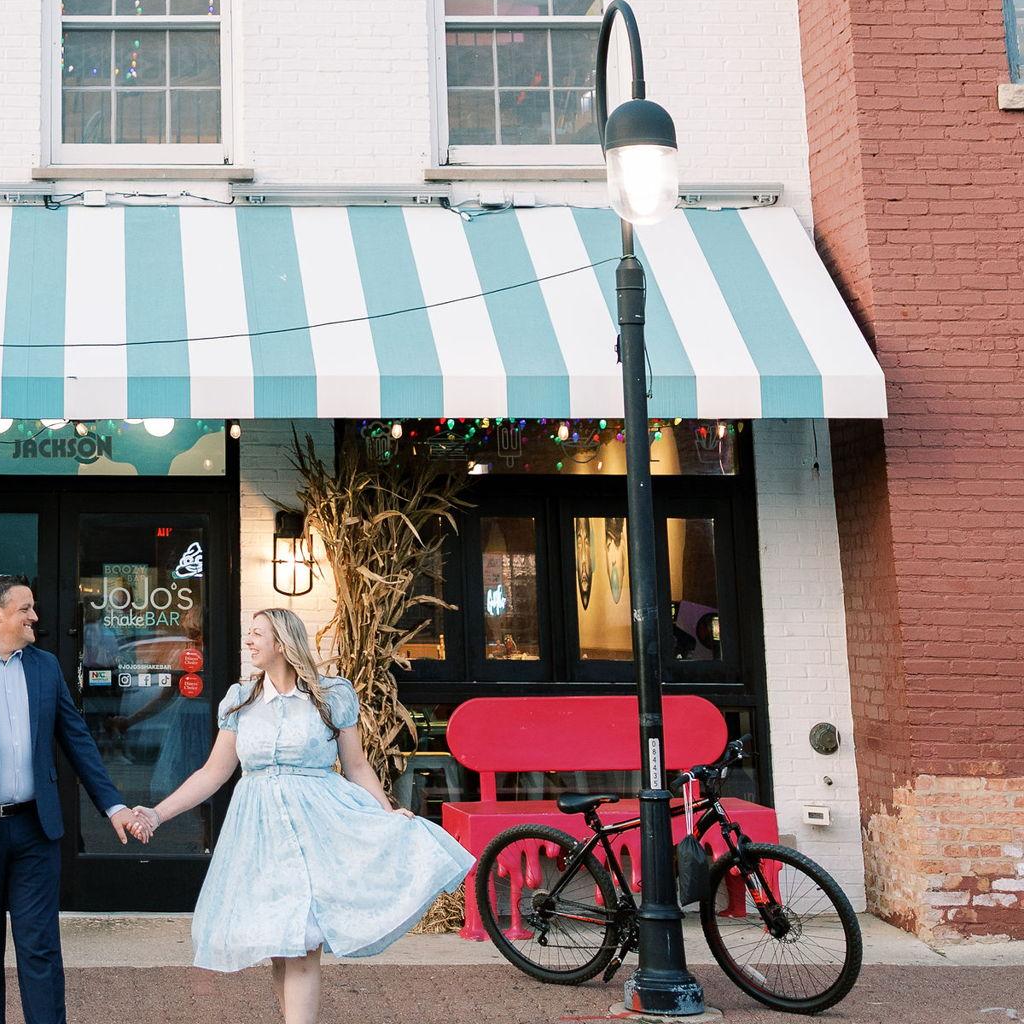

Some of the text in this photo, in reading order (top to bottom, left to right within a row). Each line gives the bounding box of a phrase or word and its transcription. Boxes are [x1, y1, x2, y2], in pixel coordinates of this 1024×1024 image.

[12, 434, 112, 462] JACKSON
[104, 564, 146, 574] BOOZY
[103, 609, 180, 627] shakeBAR
